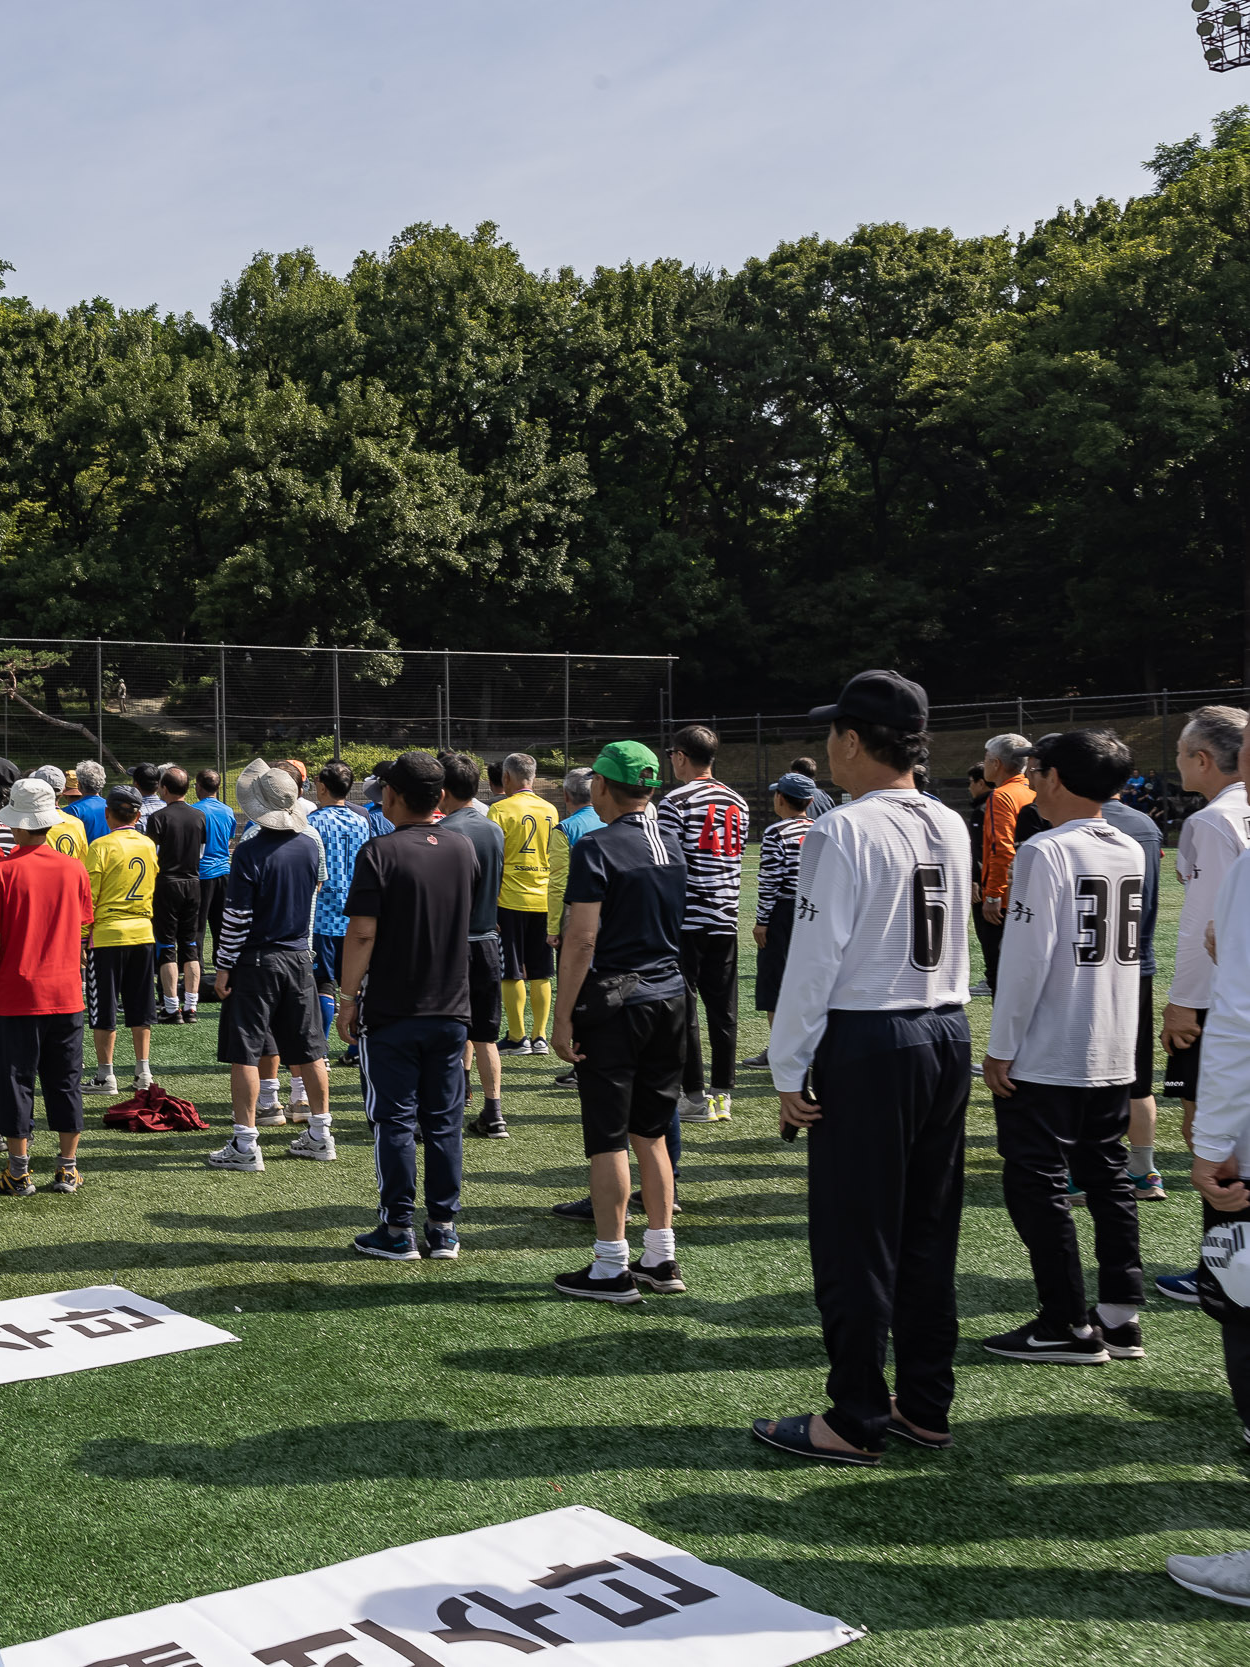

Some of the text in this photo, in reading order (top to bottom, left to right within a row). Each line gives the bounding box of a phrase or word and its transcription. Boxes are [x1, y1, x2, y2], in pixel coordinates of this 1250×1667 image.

[518, 814, 553, 854] 21
[698, 803, 742, 858] 40
[124, 856, 146, 901] 2
[909, 862, 948, 973] 6
[1071, 874, 1145, 967] 36
